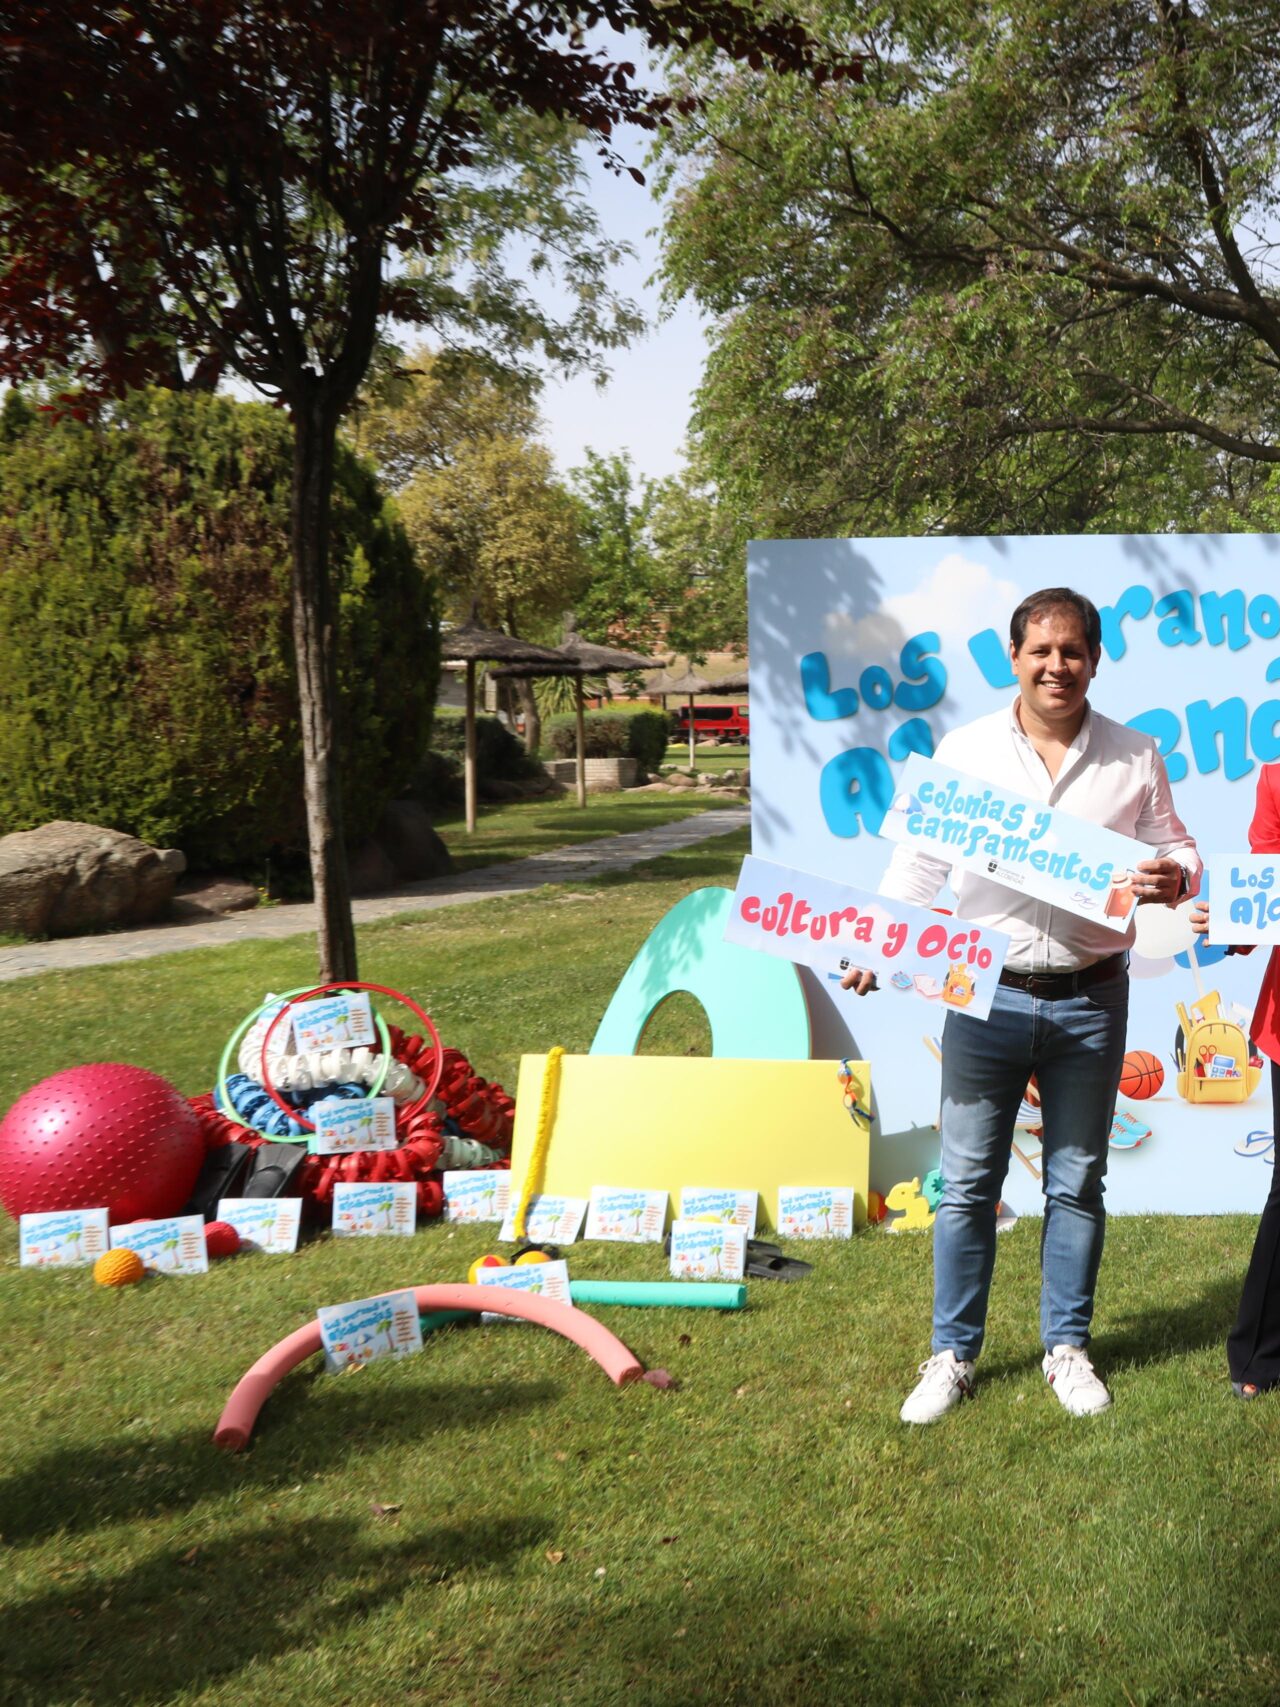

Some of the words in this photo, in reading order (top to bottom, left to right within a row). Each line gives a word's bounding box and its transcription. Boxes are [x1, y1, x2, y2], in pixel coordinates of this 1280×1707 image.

[801, 631, 947, 721] Los
[1030, 813, 1051, 841] y
[1230, 867, 1274, 889] Los
[881, 923, 908, 958] y
[916, 924, 992, 969] Ocio
